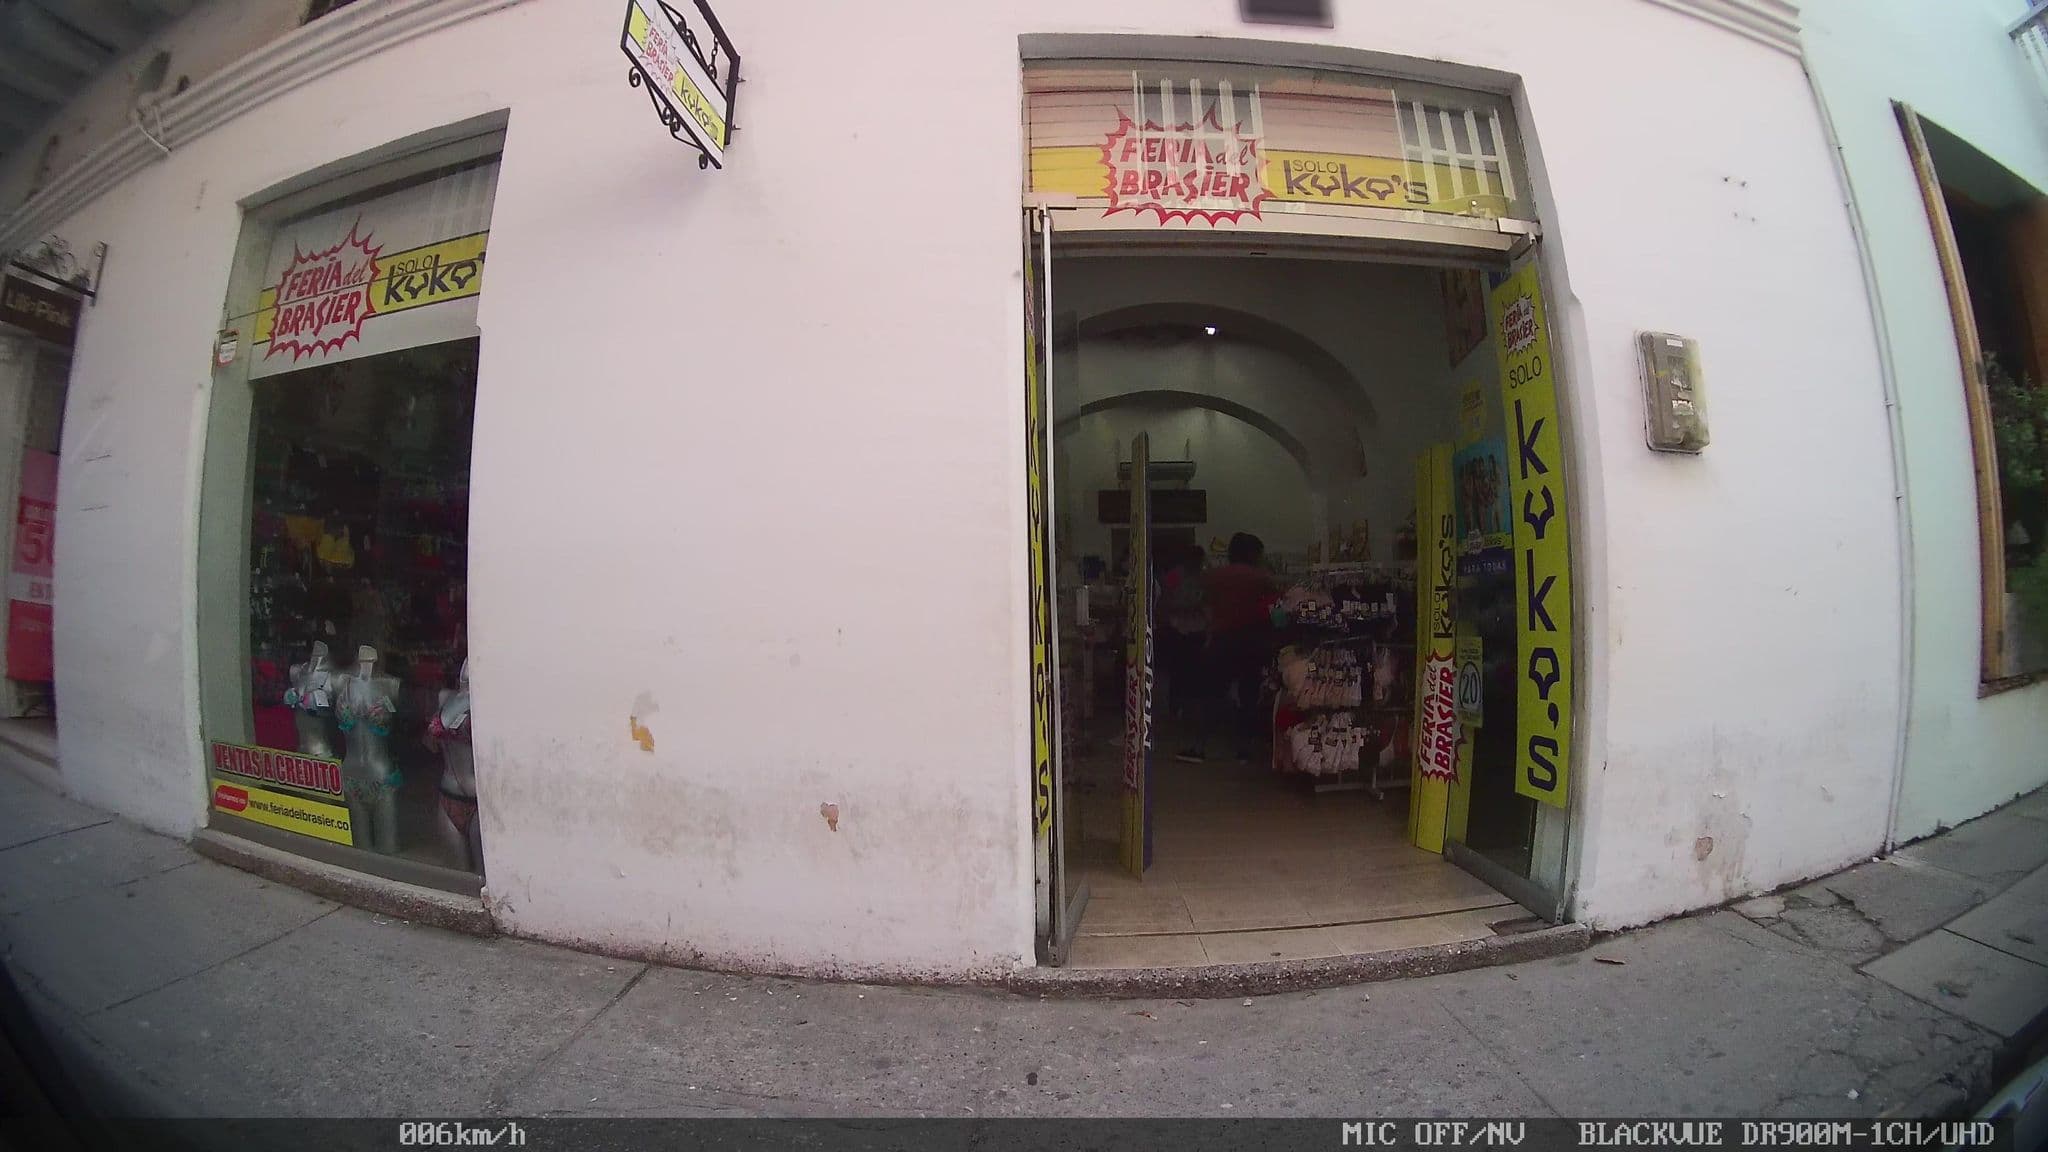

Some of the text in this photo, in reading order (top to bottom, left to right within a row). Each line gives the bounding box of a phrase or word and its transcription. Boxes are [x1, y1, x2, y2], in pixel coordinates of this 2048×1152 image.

[1119, 137, 1214, 164] FERIA
[1292, 159, 1339, 174] SOLO
[1119, 166, 1250, 205] BRASIER
[285, 257, 369, 301] FERIA del
[398, 255, 433, 274] SOLO
[277, 290, 361, 337] BRASIER
[1509, 356, 1542, 389] SOLO
[1462, 672, 1478, 704] 20
[1126, 676, 1138, 783] BRASIER
[1420, 665, 1438, 766] FERIA del
[1434, 666, 1455, 770] BRASIER
[213, 743, 344, 796] VENTAS A CREDITO
[249, 800, 349, 832] www.feriadelbrasier.co
